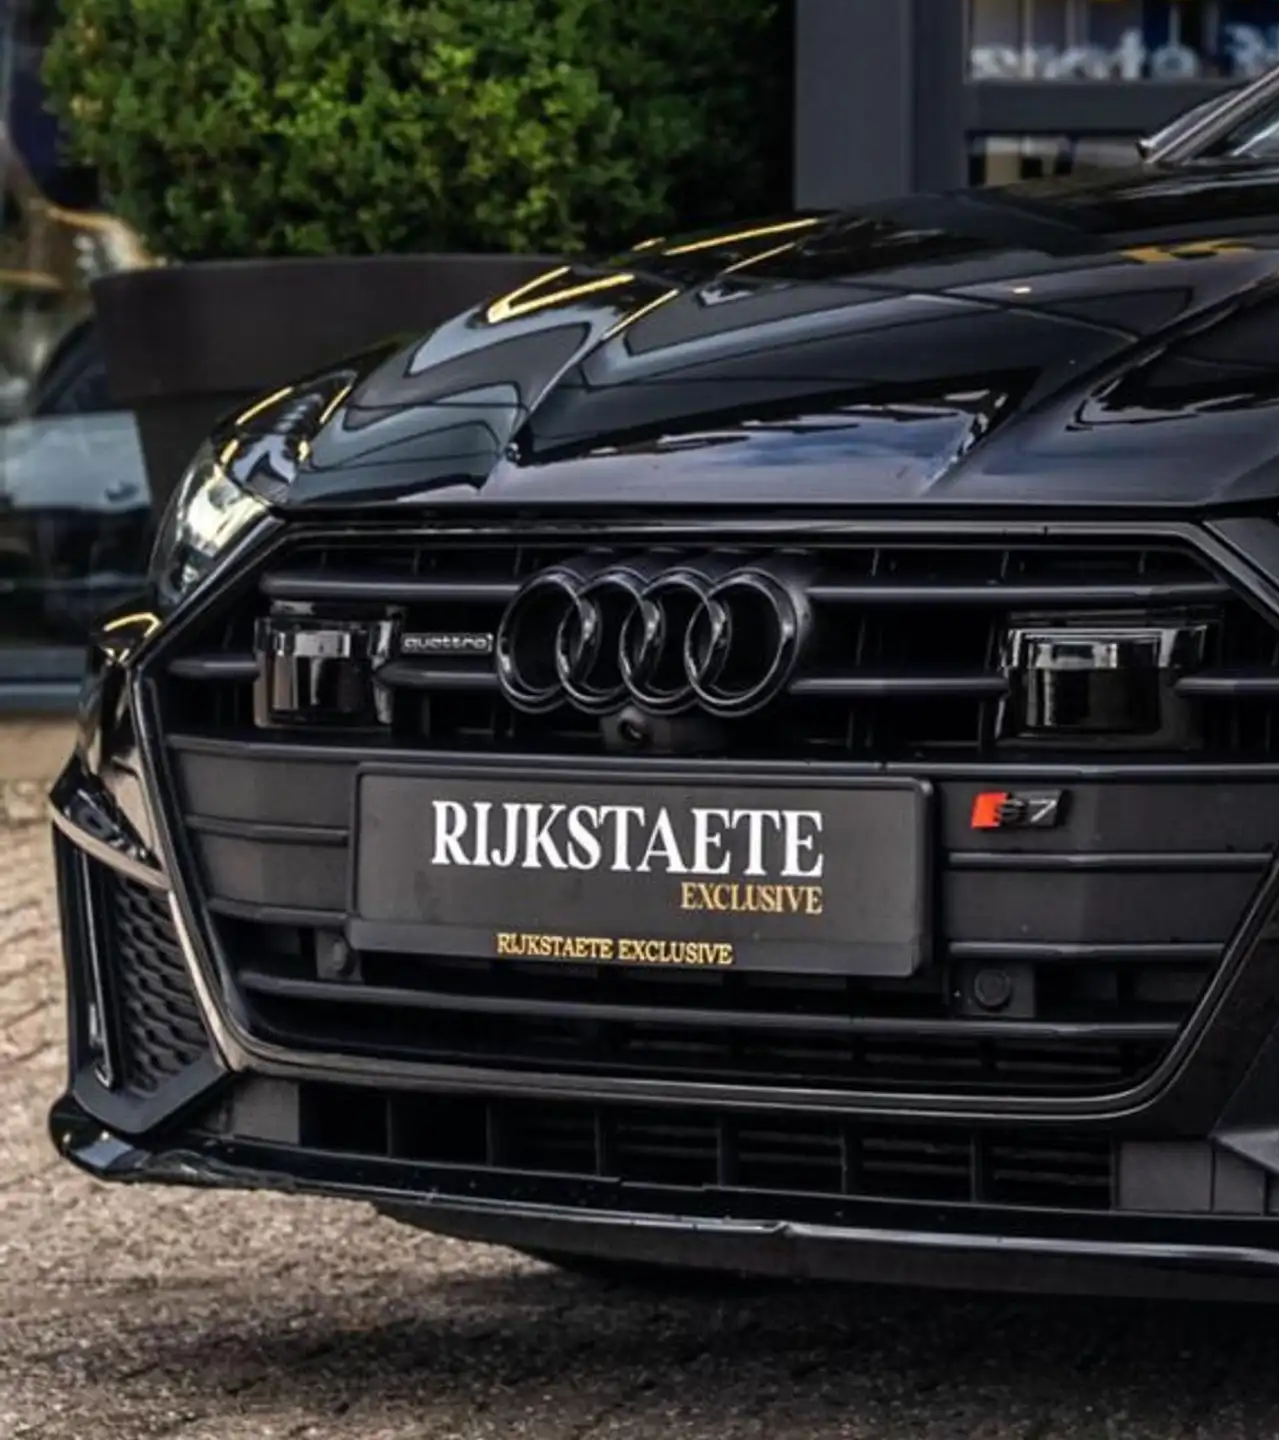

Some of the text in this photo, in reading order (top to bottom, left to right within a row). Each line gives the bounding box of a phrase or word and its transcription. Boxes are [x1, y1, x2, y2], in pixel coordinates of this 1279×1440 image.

[431, 799, 824, 878] RIJKSTAETE
[680, 881, 823, 915] EXCLUSIVE
[496, 932, 733, 965] RIJKSTAETE EXCLUSIVE
